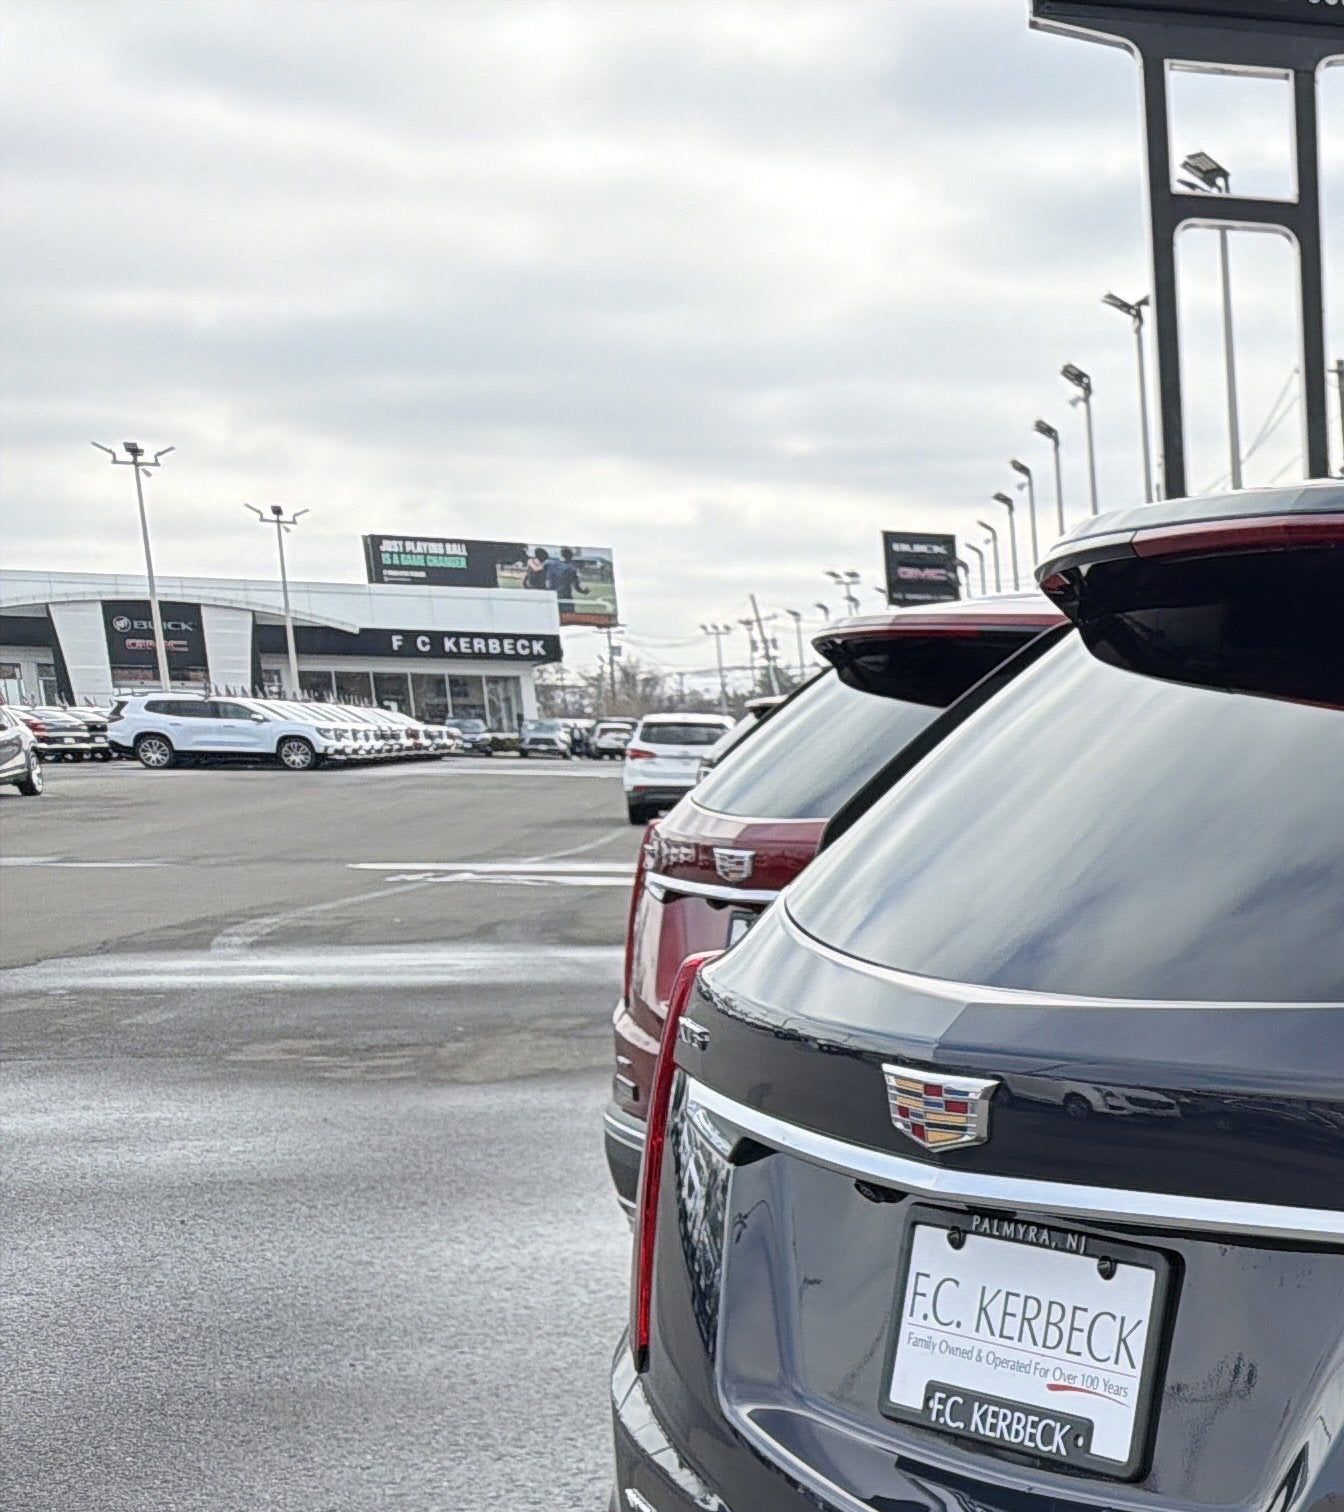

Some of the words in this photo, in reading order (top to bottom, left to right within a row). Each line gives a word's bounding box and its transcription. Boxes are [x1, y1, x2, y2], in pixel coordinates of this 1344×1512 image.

[391, 635, 404, 651] F
[416, 635, 431, 652] C
[443, 636, 547, 656] KERBECK
[971, 1215, 1056, 1249] PALMYRA,
[1066, 1234, 1086, 1255] NJ
[909, 1271, 961, 1329] F.C.
[974, 1285, 1143, 1370] KERBECK
[907, 1332, 938, 1352] Family
[939, 1339, 973, 1361] Owned
[975, 1350, 984, 1363] &
[986, 1351, 1032, 1375] Operated
[1033, 1362, 1049, 1379] For
[1052, 1366, 1078, 1386] Over
[1081, 1373, 1100, 1391] 100
[1101, 1378, 1129, 1398] Years
[970, 1405, 1071, 1456] KERBECK
